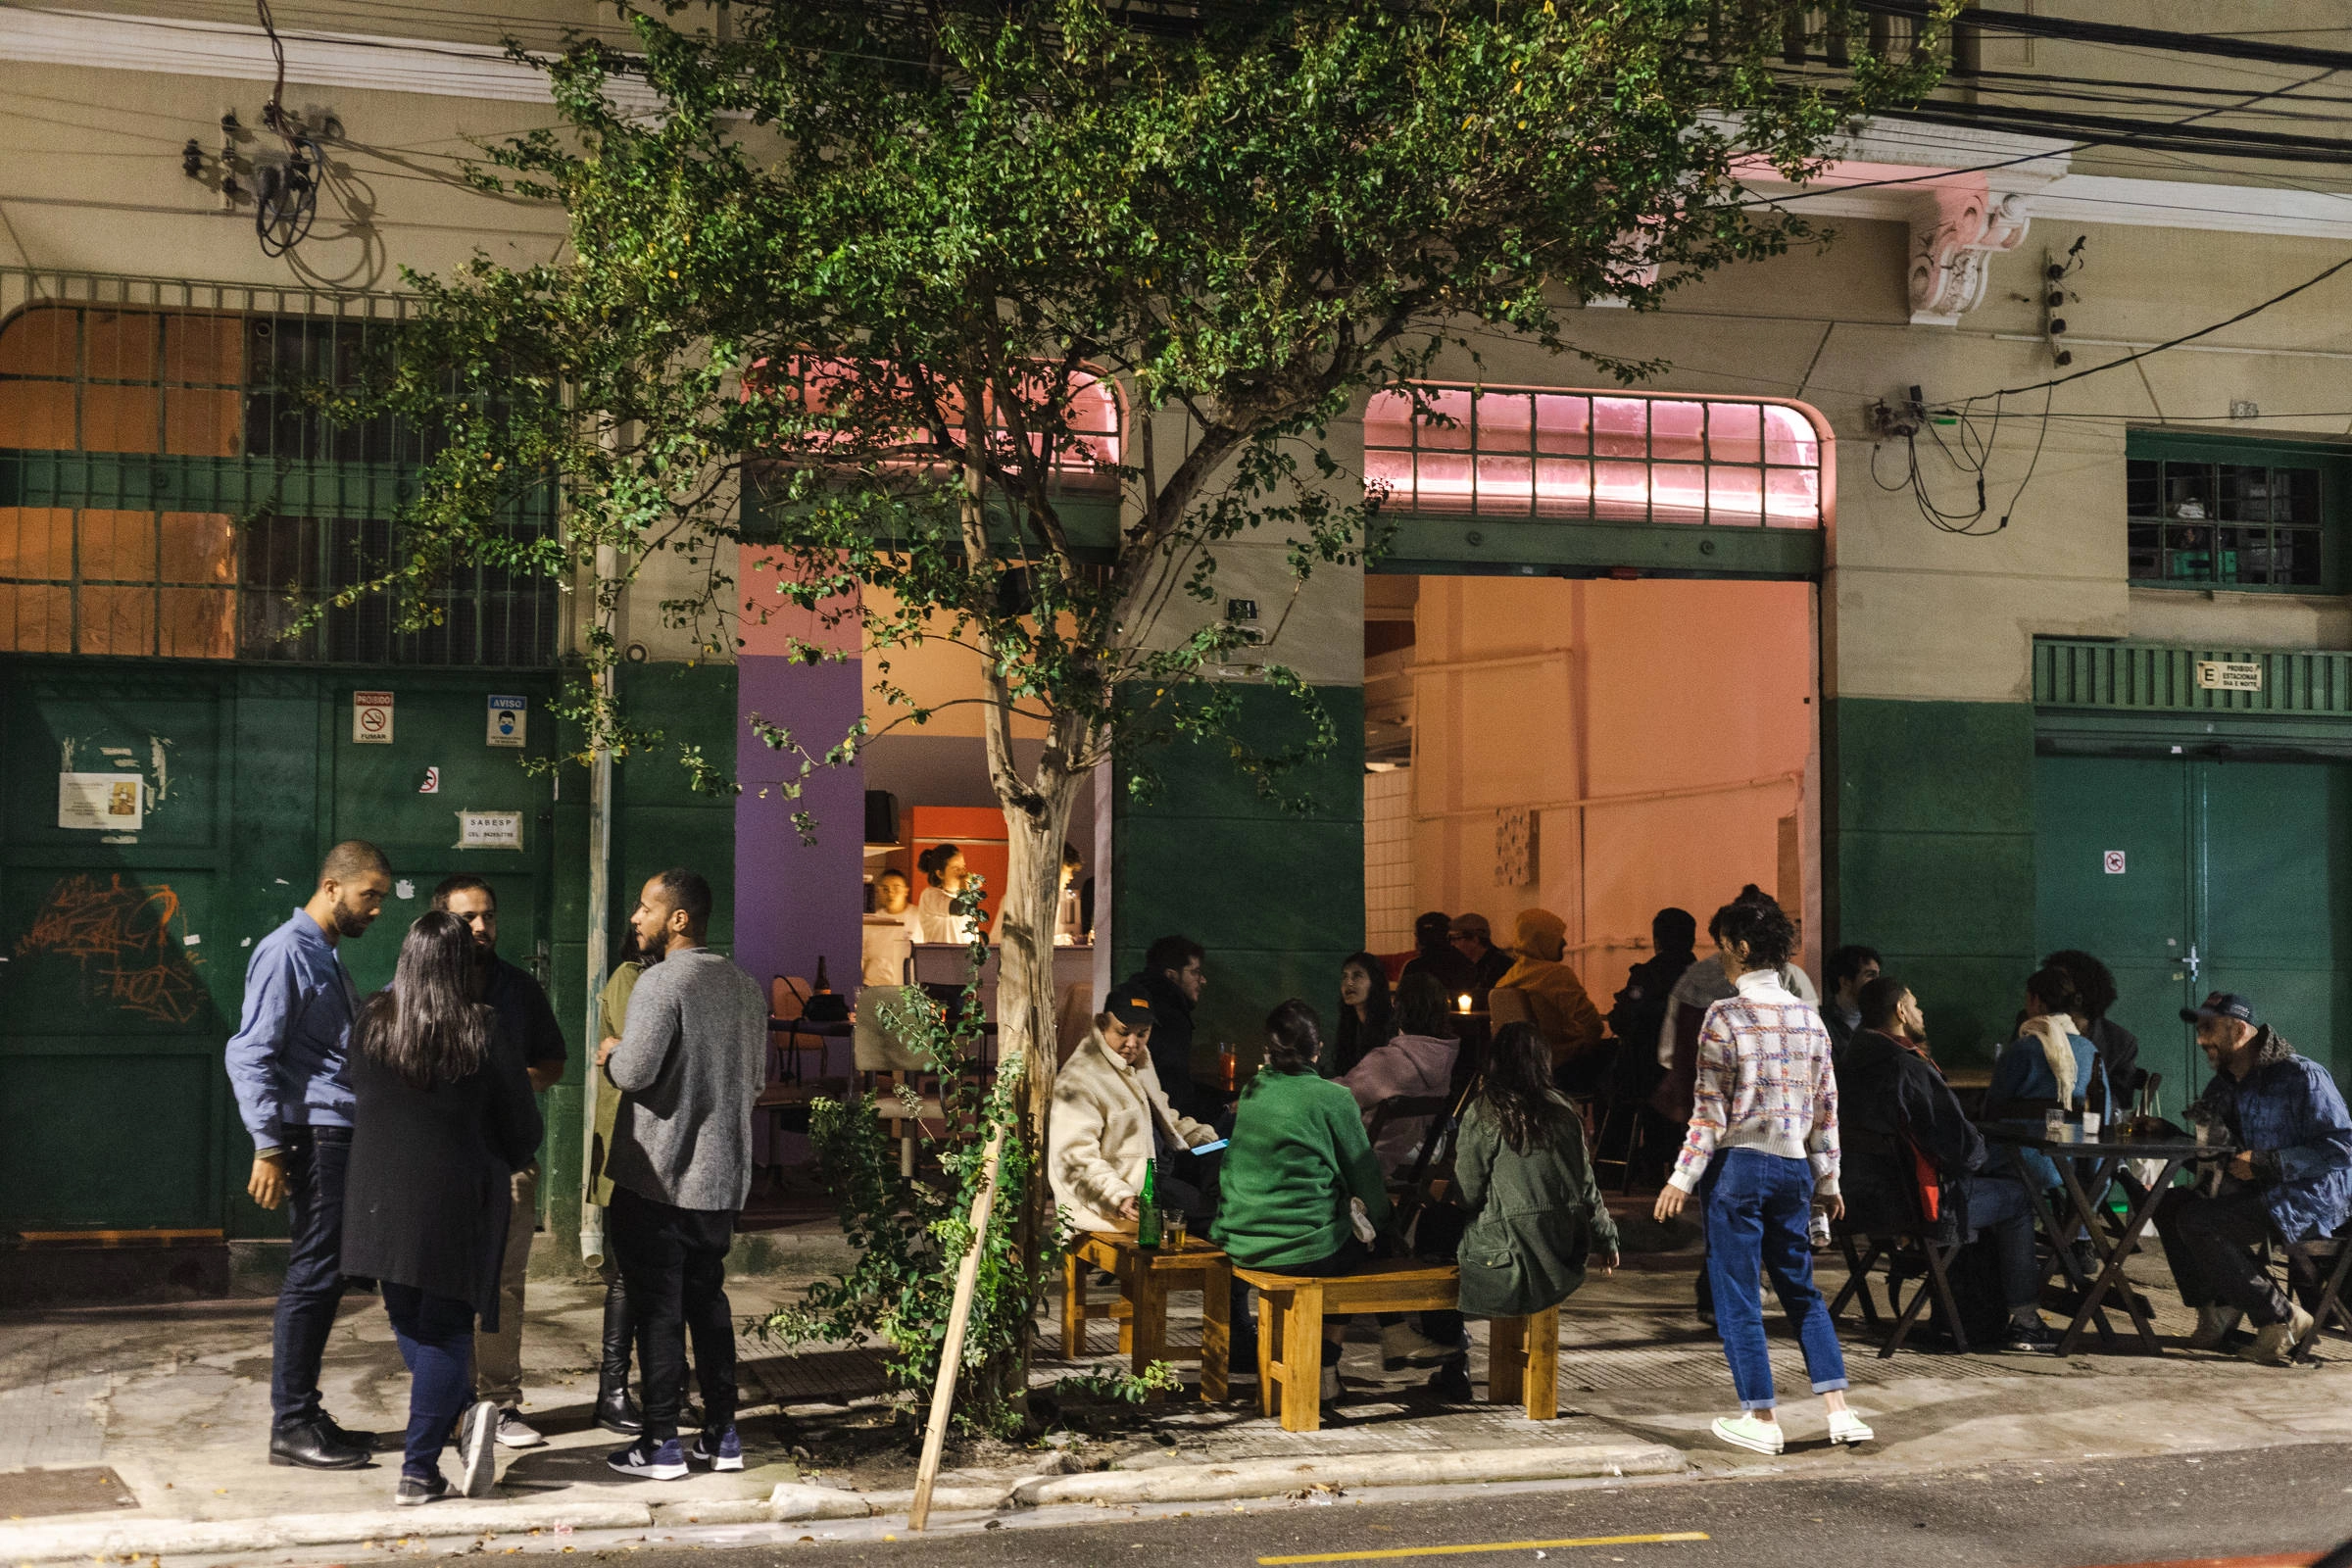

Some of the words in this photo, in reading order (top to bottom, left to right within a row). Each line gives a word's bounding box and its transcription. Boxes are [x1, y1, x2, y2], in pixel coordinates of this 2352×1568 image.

[2204, 668, 2215, 682] E
[357, 695, 391, 705] PROIBIDO
[493, 699, 522, 708] AVISO
